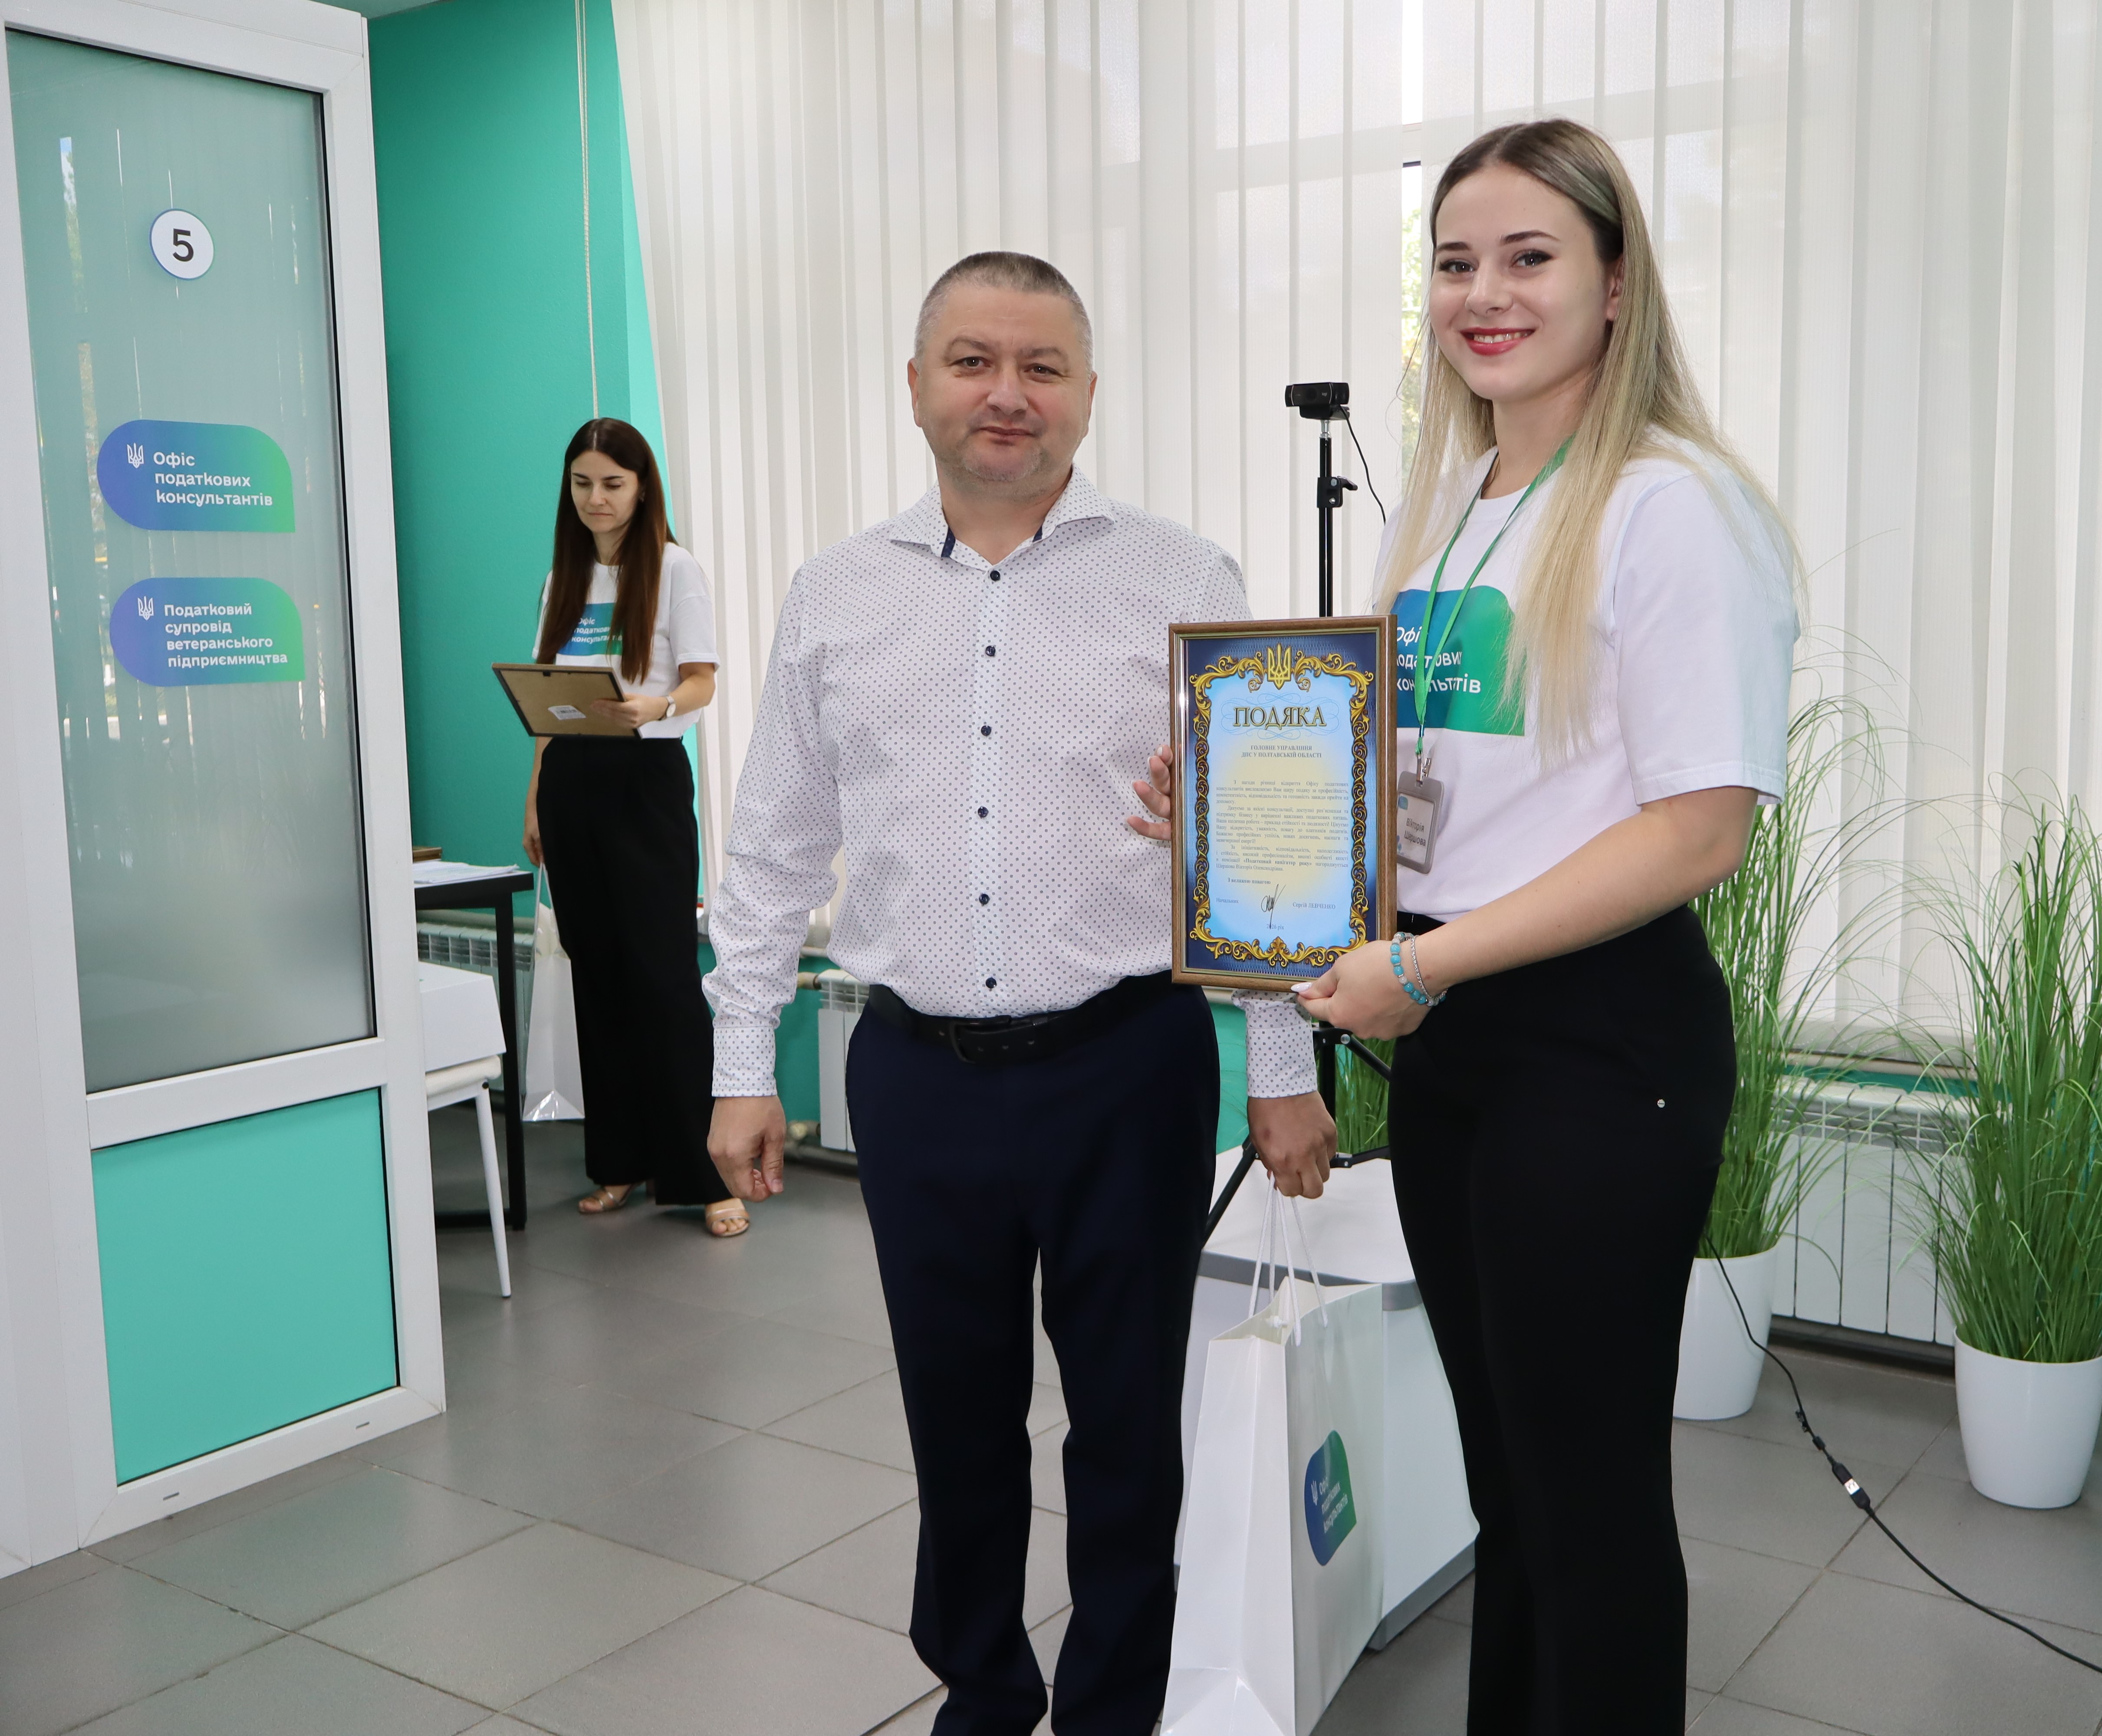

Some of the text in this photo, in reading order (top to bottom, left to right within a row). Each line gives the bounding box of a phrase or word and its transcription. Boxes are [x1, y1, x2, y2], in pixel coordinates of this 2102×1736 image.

[173, 228, 194, 262] 5
[153, 452, 195, 468] Офіс
[155, 472, 251, 487] податкових
[156, 490, 273, 507] консультантів
[164, 603, 252, 618] Податковий
[165, 620, 232, 636] супровід
[1397, 626, 1422, 646] Офі
[167, 636, 273, 651] ветеранського
[168, 654, 287, 668] підприємництва
[1233, 705, 1326, 730] ПОДЯКА
[1406, 818, 1424, 832] Вікторія
